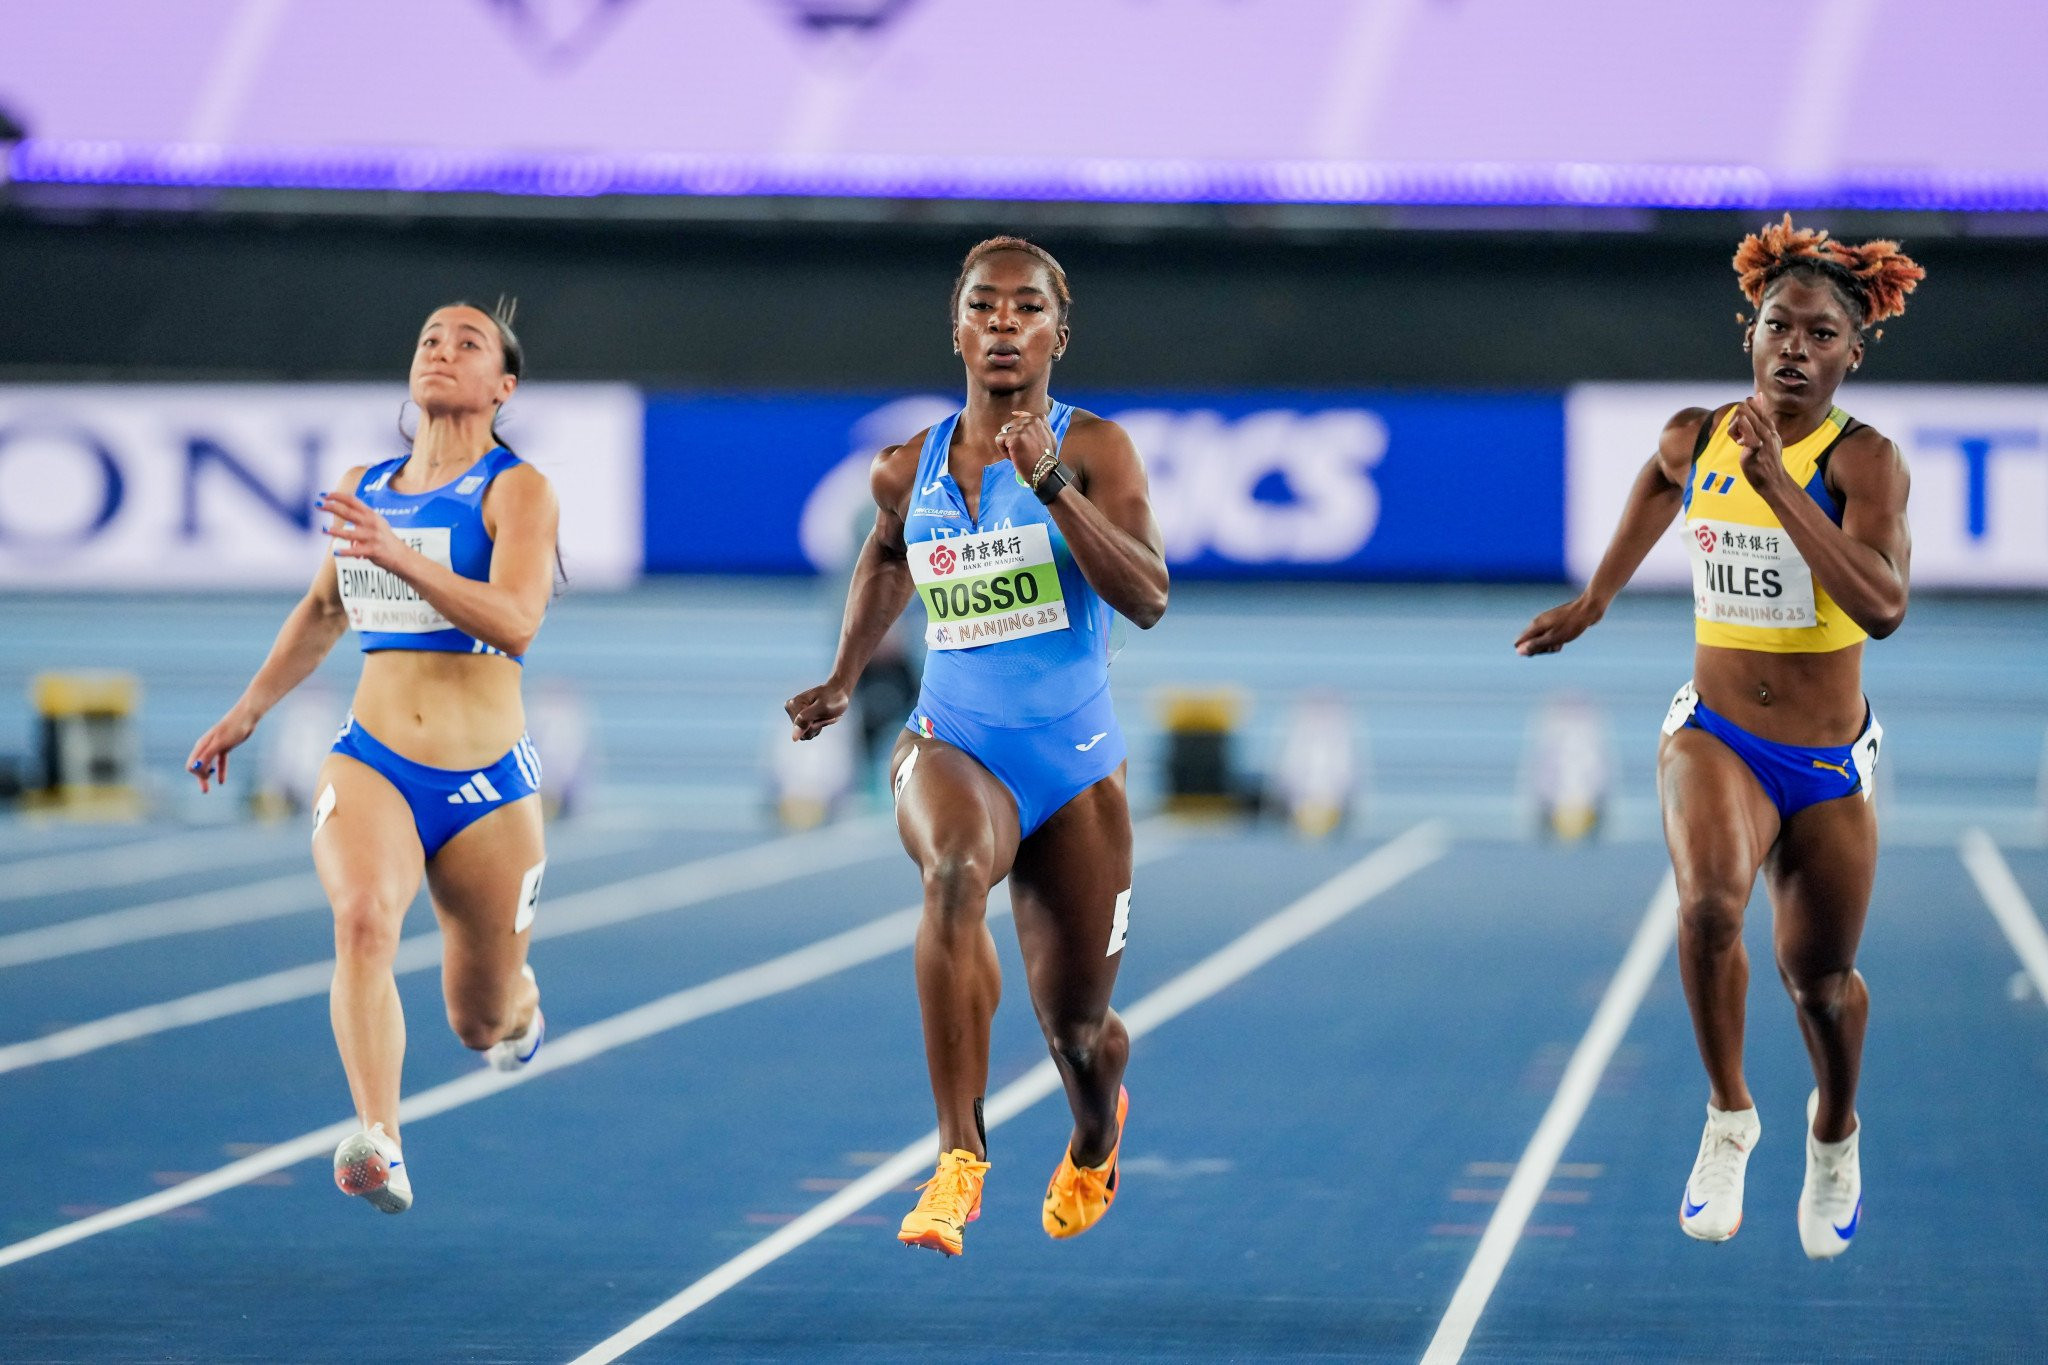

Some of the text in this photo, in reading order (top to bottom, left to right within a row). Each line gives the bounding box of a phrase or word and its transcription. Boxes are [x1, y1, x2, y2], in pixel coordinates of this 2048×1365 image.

[930, 517, 1013, 541] ITAIA
[1722, 530, 1780, 553] 南京银行
[961, 536, 1021, 562] 南京银行
[963, 563, 982, 571] BANK
[995, 556, 1025, 566] NANJING
[342, 568, 424, 601] EMMANOUIL
[1705, 559, 1783, 598] NILES
[929, 572, 1039, 619] DOSSO
[371, 610, 429, 627] NANJING
[1715, 603, 1806, 621] NANJING 25
[958, 607, 1059, 643] NANJING 25
